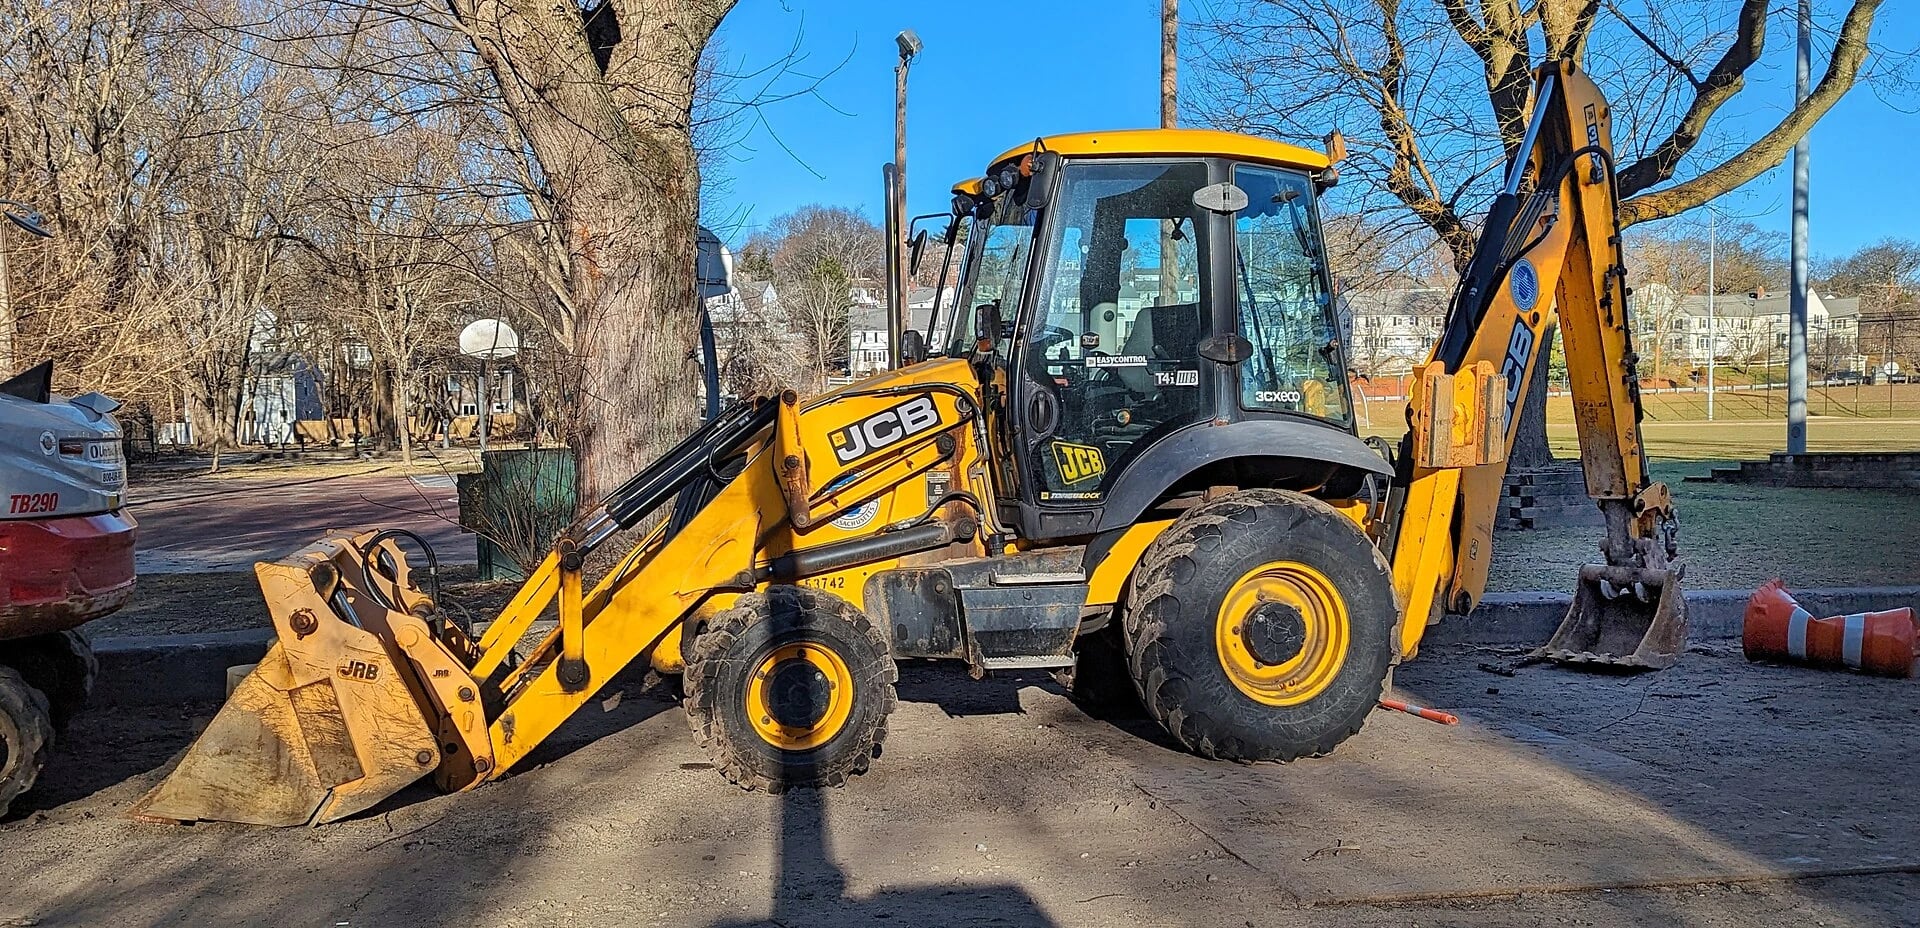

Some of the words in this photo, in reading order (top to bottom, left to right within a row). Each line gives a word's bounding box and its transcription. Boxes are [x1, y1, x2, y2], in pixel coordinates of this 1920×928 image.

[1155, 372, 1175, 385] T4i
[1504, 321, 1532, 433] CB
[837, 397, 938, 461] JCB
[1061, 446, 1103, 480] JCB
[10, 493, 58, 514] TB290
[341, 660, 379, 680] JRB
[433, 669, 449, 678] JRB
